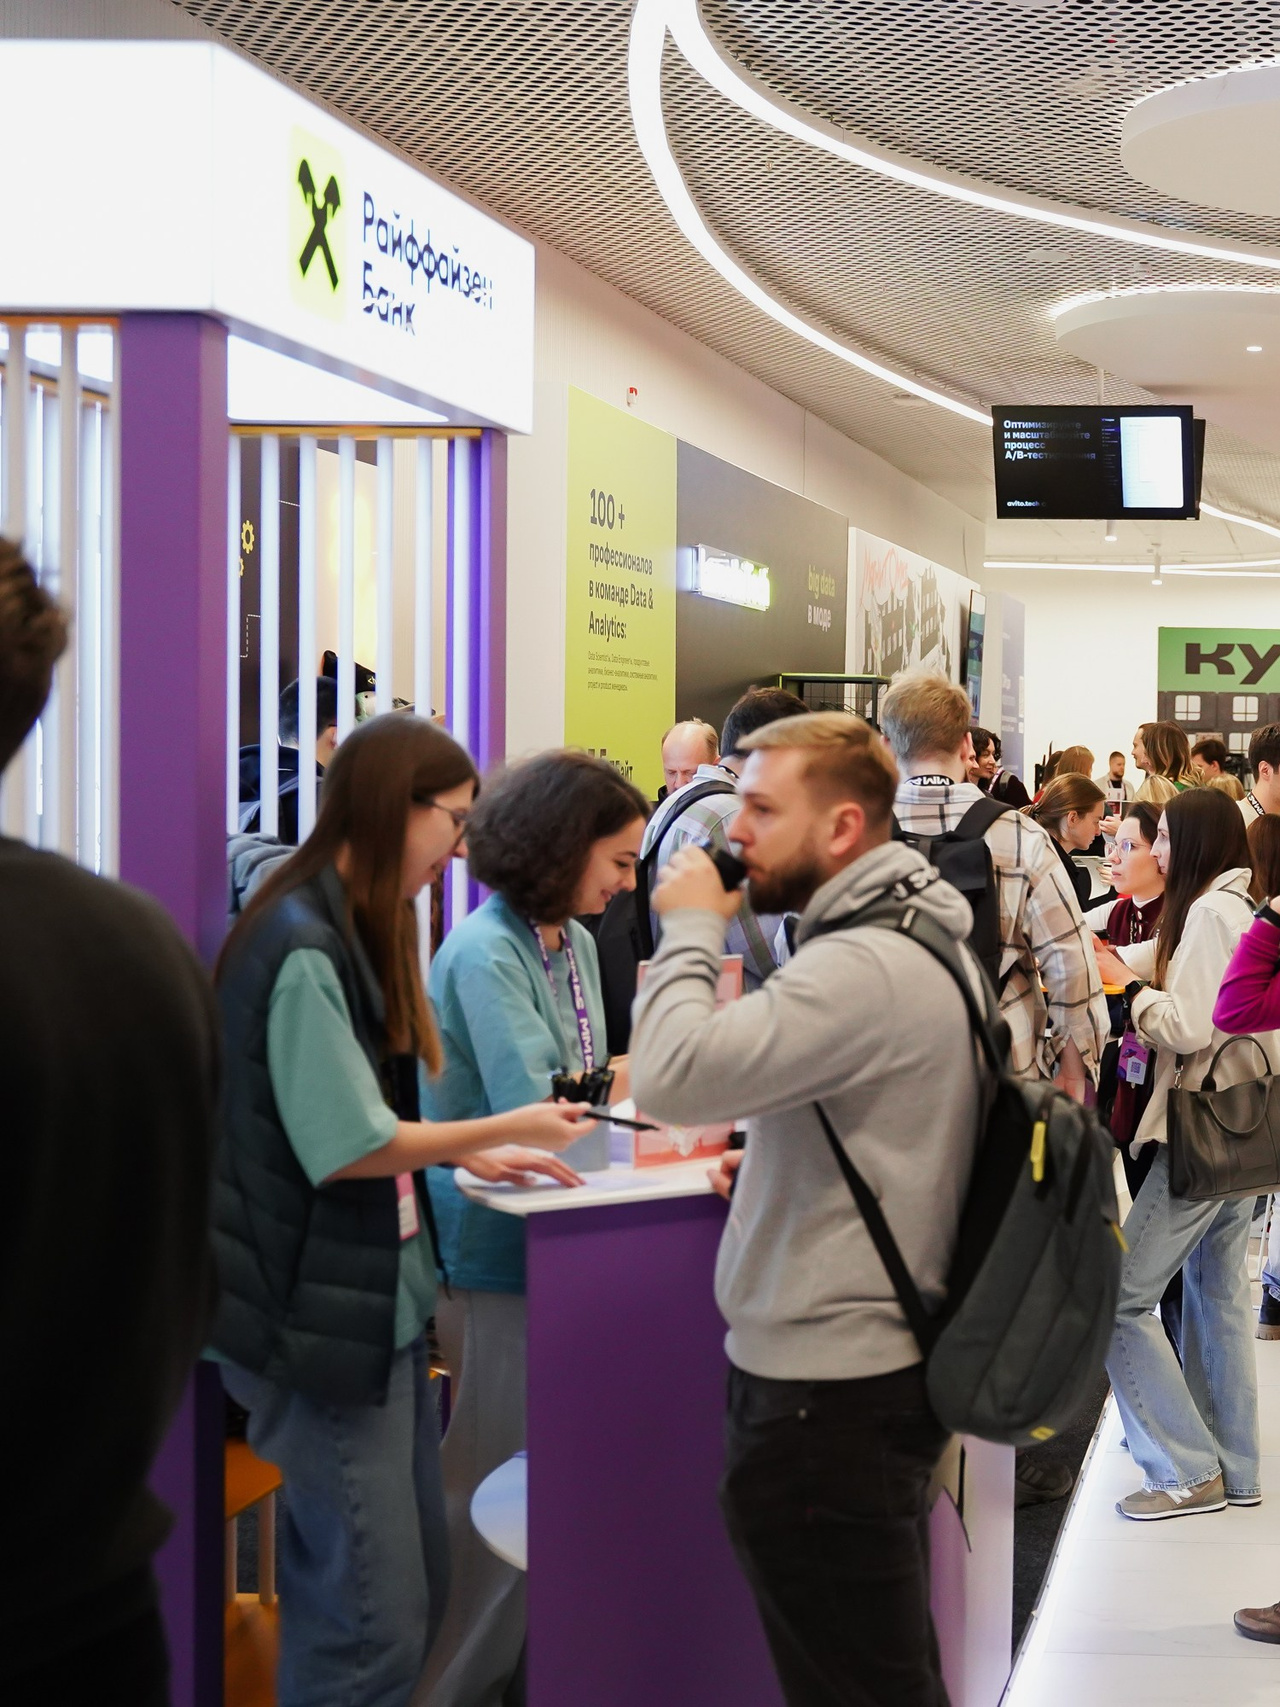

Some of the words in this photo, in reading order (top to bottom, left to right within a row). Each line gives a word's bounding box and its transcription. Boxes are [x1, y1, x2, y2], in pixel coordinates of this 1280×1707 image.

[363, 191, 493, 310] Райффайзен
[363, 260, 415, 336] Банк
[1004, 441, 1046, 451] процесс
[1007, 500, 1040, 508] avito.tech
[589, 541, 653, 576] профессионалов
[589, 580, 594, 597] в
[595, 581, 629, 608] команде
[630, 583, 647, 608] Data
[648, 587, 654, 610] &
[588, 610, 627, 643] Analytics:
